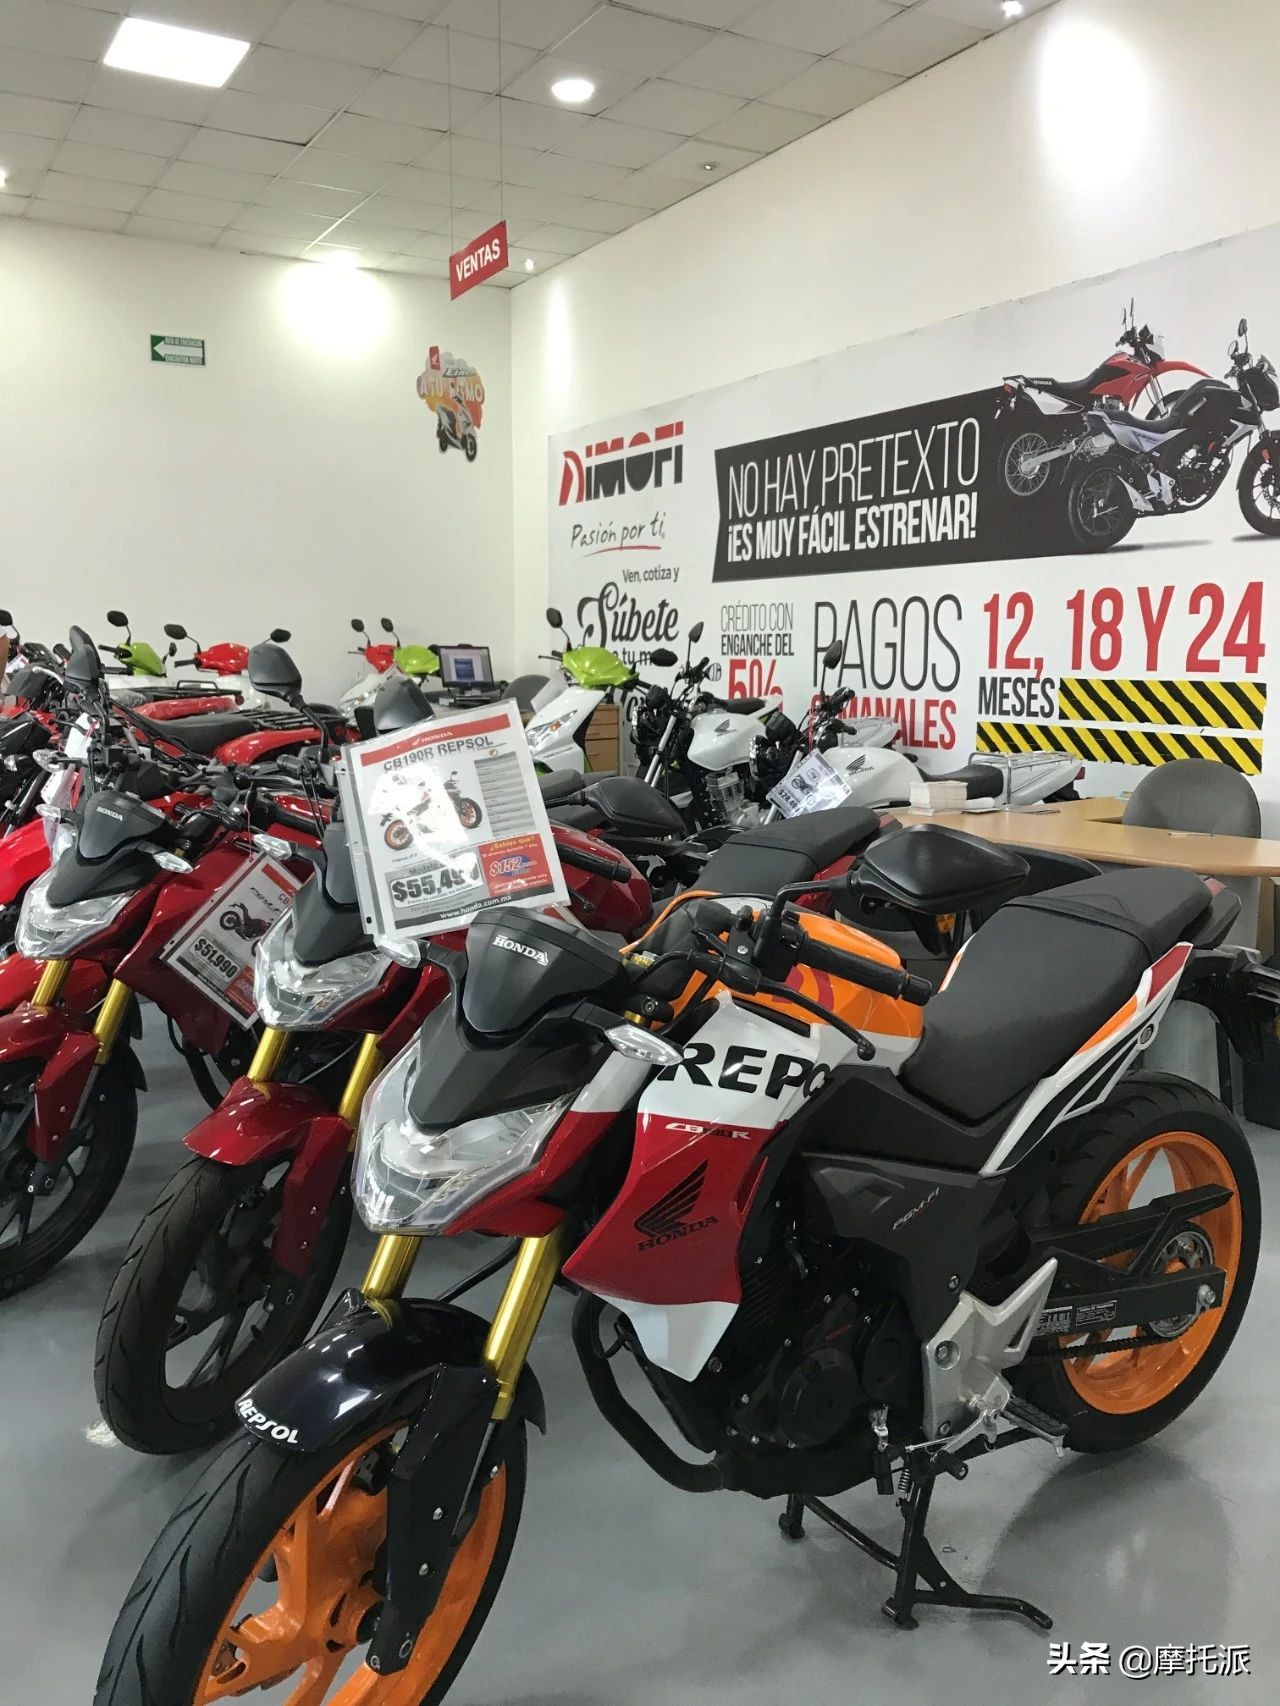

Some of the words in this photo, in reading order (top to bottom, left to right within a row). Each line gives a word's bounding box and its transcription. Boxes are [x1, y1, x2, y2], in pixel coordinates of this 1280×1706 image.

[456, 238, 501, 282] VENTAS
[728, 461, 759, 520] NO
[763, 449, 816, 515] HAY
[821, 417, 980, 507] PRETEXTO
[571, 520, 617, 548] Pasión
[619, 524, 646, 551] por
[727, 522, 752, 563] ¡ES
[755, 516, 796, 560] MUY
[798, 504, 850, 556] FÁCIL
[854, 491, 978, 550] ESTRENAR!
[622, 568, 642, 584] Ven,
[643, 565, 672, 582] cotiza
[672, 566, 680, 583] y
[577, 581, 680, 648] Súbete
[720, 600, 766, 633] CRÉDITO
[769, 602, 794, 632] CON
[983, 591, 1044, 680] 12,
[1066, 587, 1124, 672] 18
[1137, 585, 1175, 672] Y
[1185, 581, 1266, 674] 24
[622, 648, 635, 665] tu
[721, 633, 772, 657] ENGANCHE
[775, 632, 795, 657] DEL
[814, 594, 962, 693] PAGOS
[977, 676, 1055, 718] MESES
[420, 730, 454, 744] HONDA
[809, 693, 956, 750] MANALES
[383, 745, 434, 772] CB190R
[437, 735, 494, 754] REPSOL
[96, 806, 124, 822] HONDA
[409, 863, 439, 876] Modelo
[440, 895, 513, 919] www.honda.com.mx
[194, 937, 238, 979] $51,990
[492, 934, 549, 967] HONDA
[637, 1215, 720, 1252] HONDA
[238, 1398, 299, 1444] REPSOL
